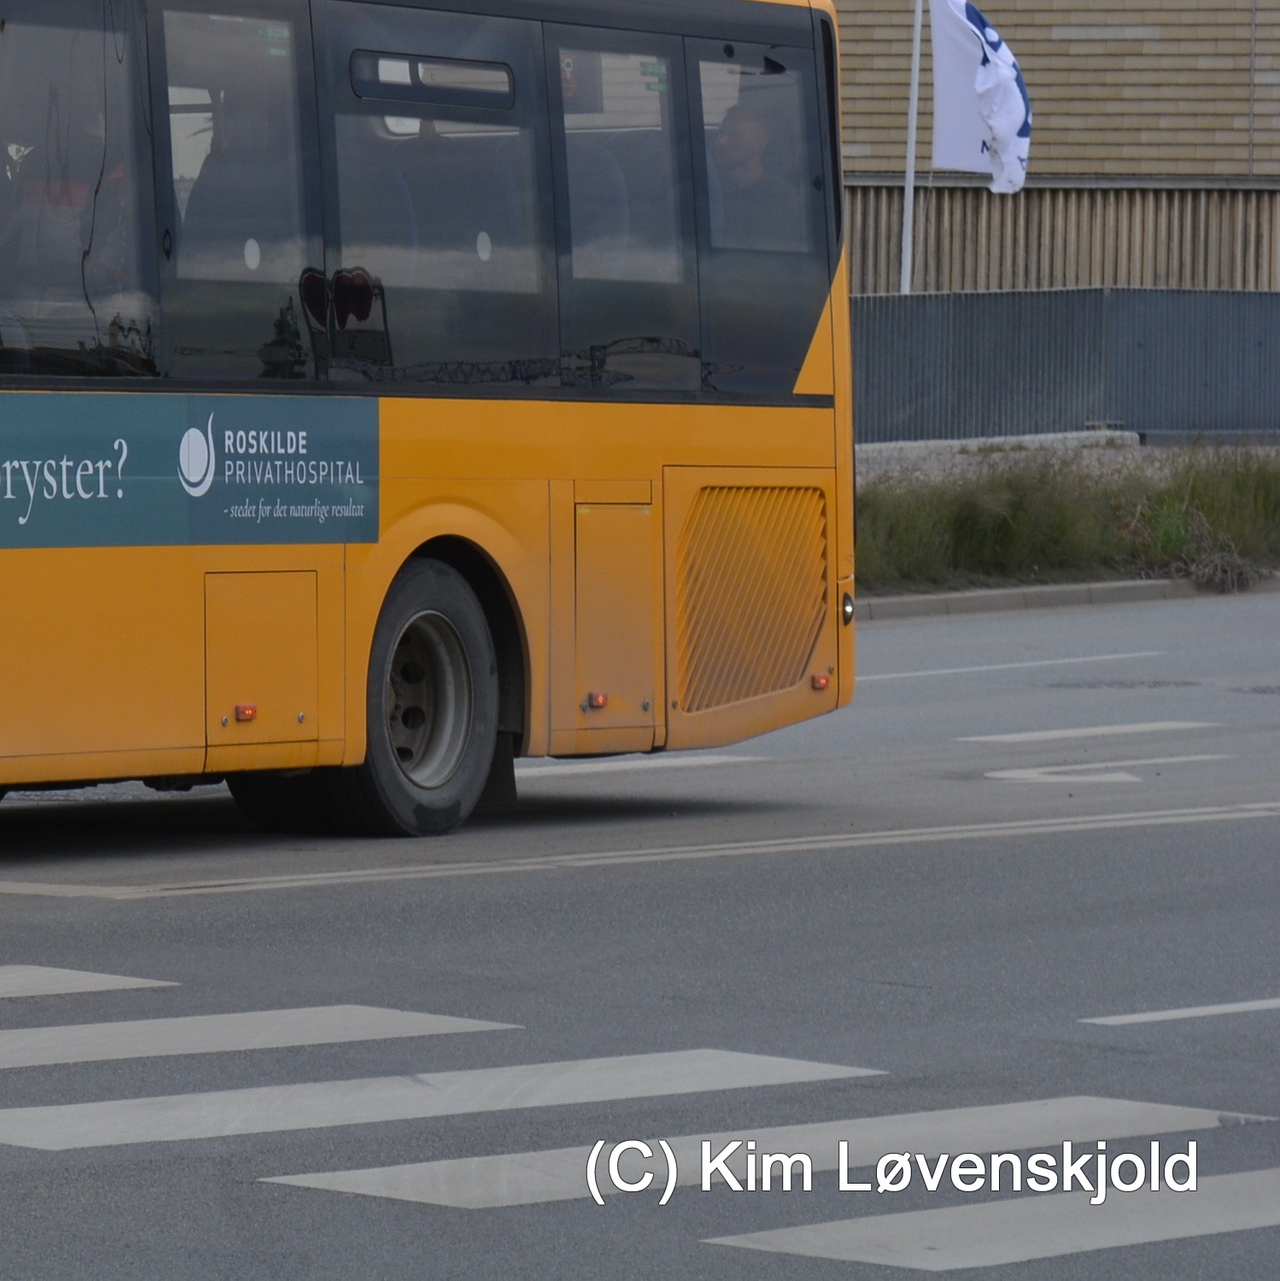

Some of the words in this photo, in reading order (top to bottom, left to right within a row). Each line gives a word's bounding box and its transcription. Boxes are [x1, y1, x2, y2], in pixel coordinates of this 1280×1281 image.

[224, 430, 307, 454] ROSKILDE
[224, 460, 364, 485] PRIVATHOSPITAL
[230, 497, 257, 518] stedet
[256, 497, 272, 524] for
[273, 497, 288, 518] det
[289, 497, 330, 524] naturlige
[331, 497, 365, 518] resultat
